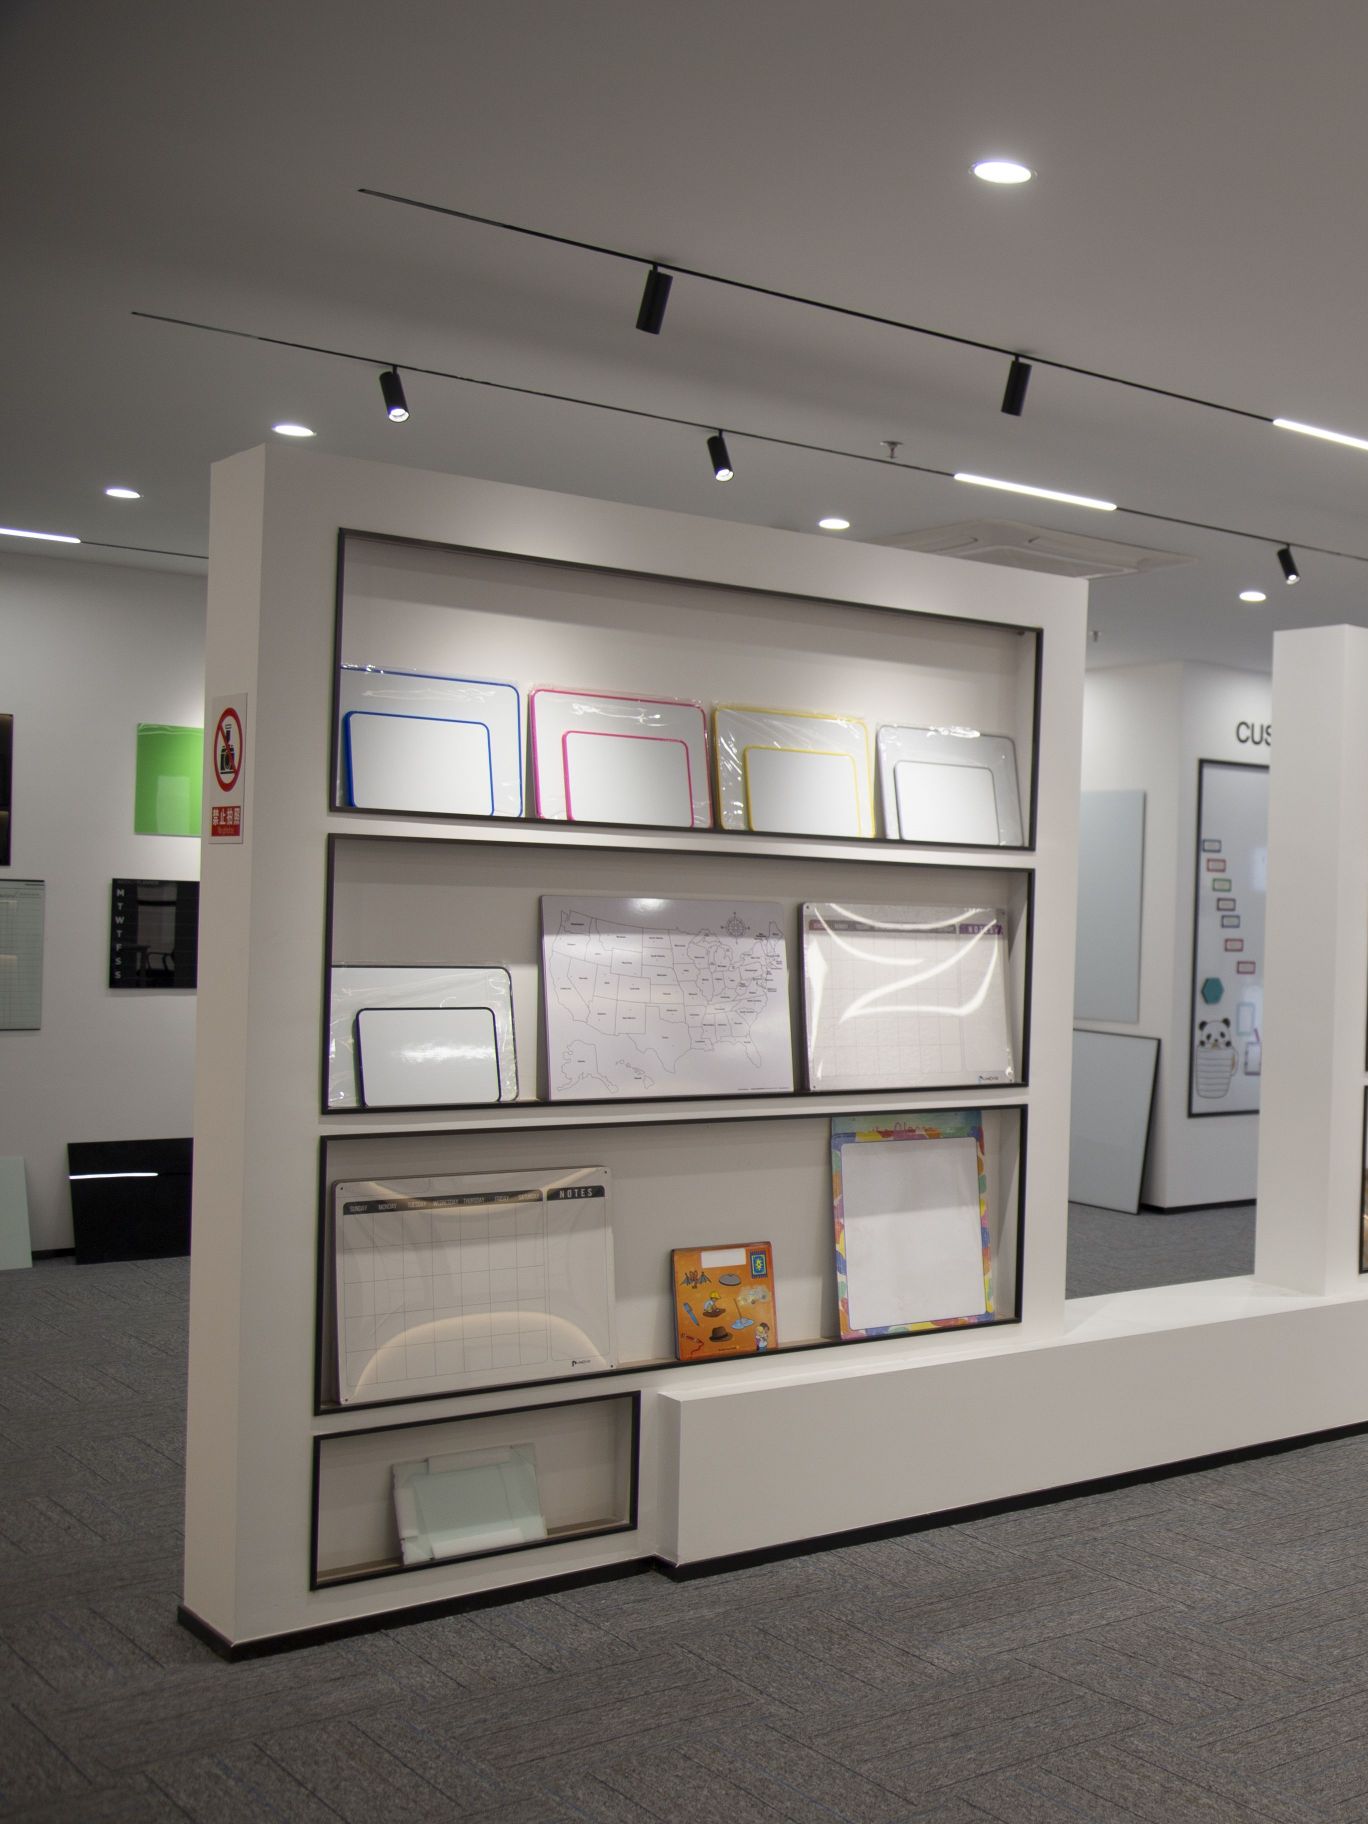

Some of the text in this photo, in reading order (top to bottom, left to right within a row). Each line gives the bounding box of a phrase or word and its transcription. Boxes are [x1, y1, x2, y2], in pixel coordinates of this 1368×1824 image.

[212, 807, 240, 826] 禁止拍照
[116, 888, 125, 897] M
[117, 902, 124, 910] T
[115, 916, 125, 924] W
[116, 930, 123, 938] T
[115, 957, 122, 966] S
[114, 971, 122, 979] S
[559, 1187, 594, 1199] NOTES
[378, 1202, 397, 1211] MONDAY
